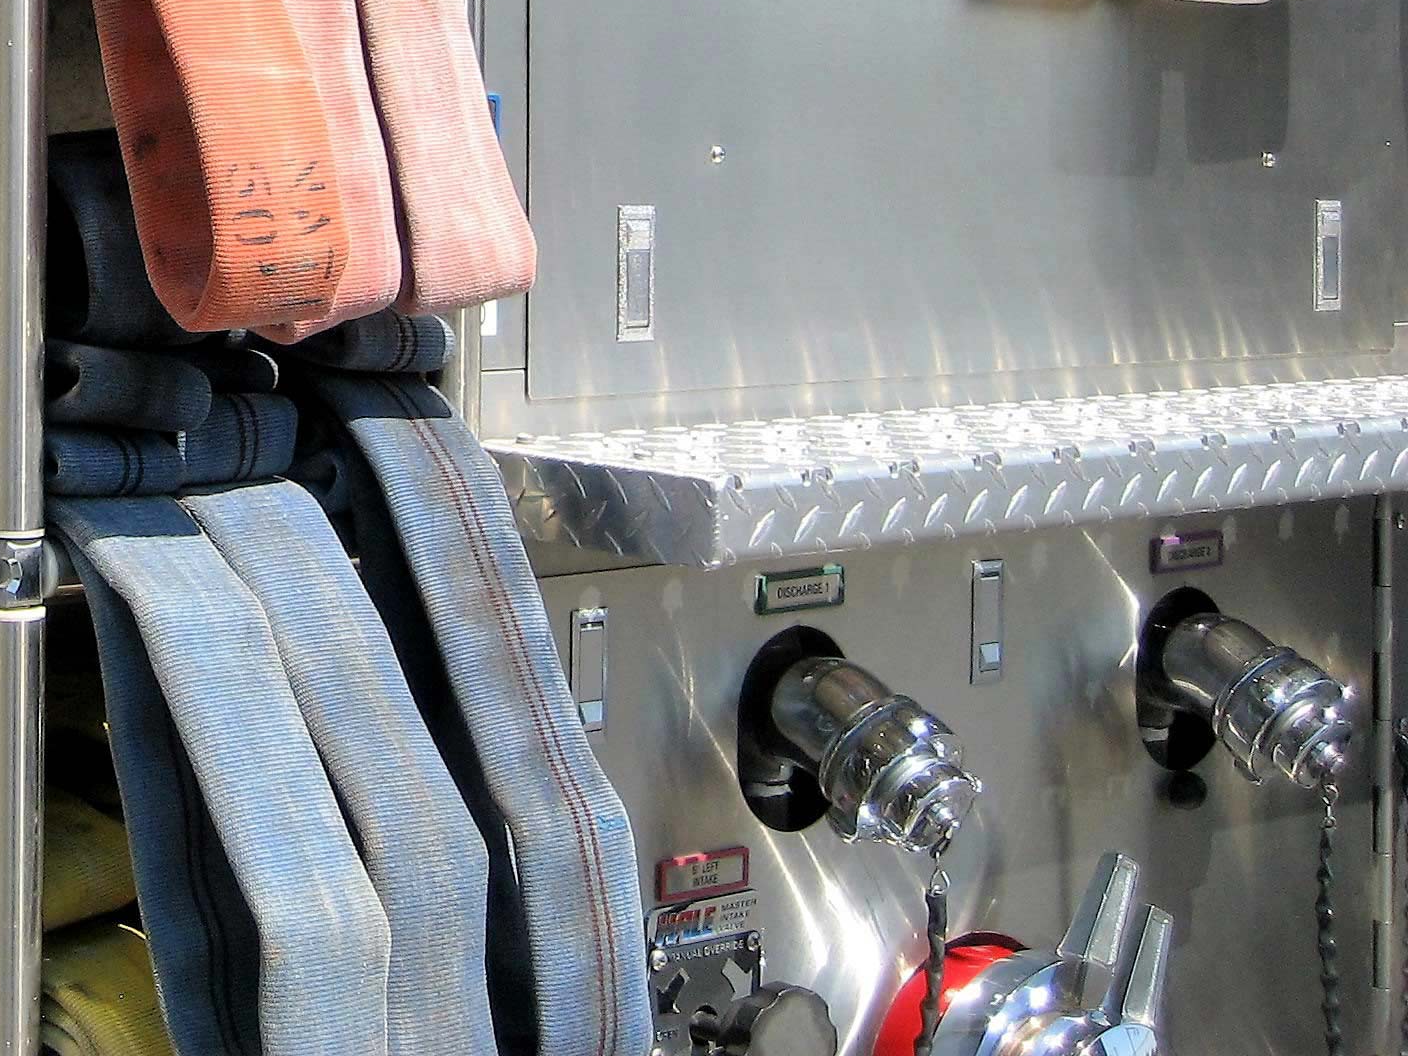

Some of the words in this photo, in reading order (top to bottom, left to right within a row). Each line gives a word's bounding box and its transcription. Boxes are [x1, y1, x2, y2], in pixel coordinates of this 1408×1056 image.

[777, 582, 823, 599] DISCHARGE
[702, 861, 719, 874] LEFT
[721, 898, 757, 911] MASTER
[704, 939, 744, 956] OVERRIDE
